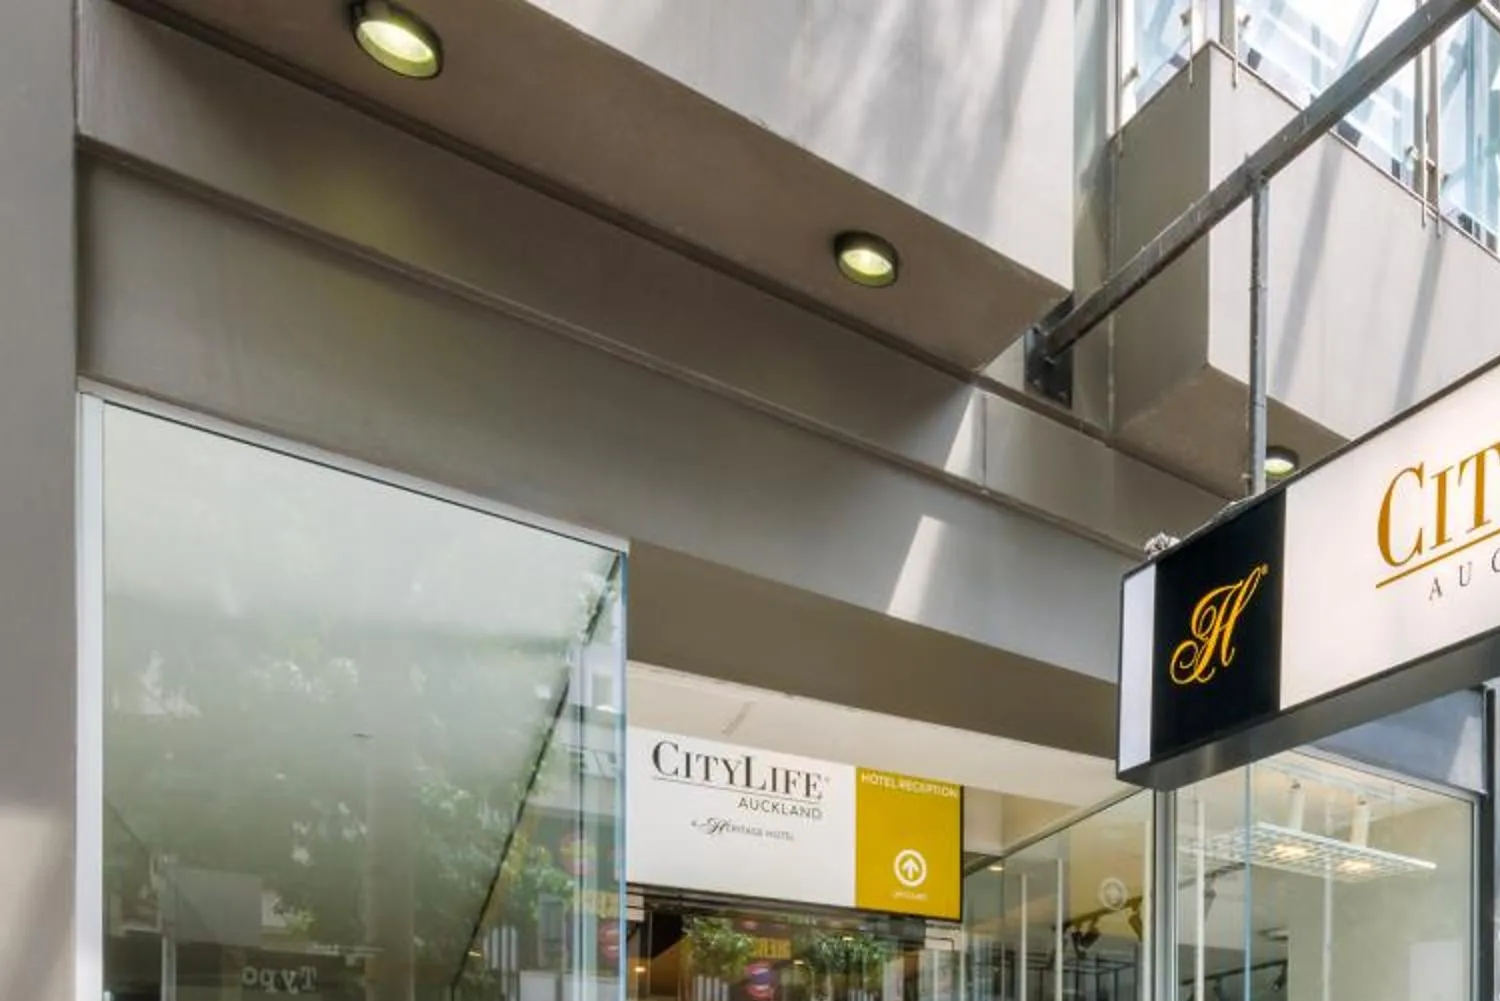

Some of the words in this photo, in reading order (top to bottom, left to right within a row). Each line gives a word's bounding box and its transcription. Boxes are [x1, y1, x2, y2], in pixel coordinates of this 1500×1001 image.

[861, 771, 896, 790] HOTEL
[898, 779, 959, 798] RECEPTION
[737, 797, 824, 821] AUCKLAND
